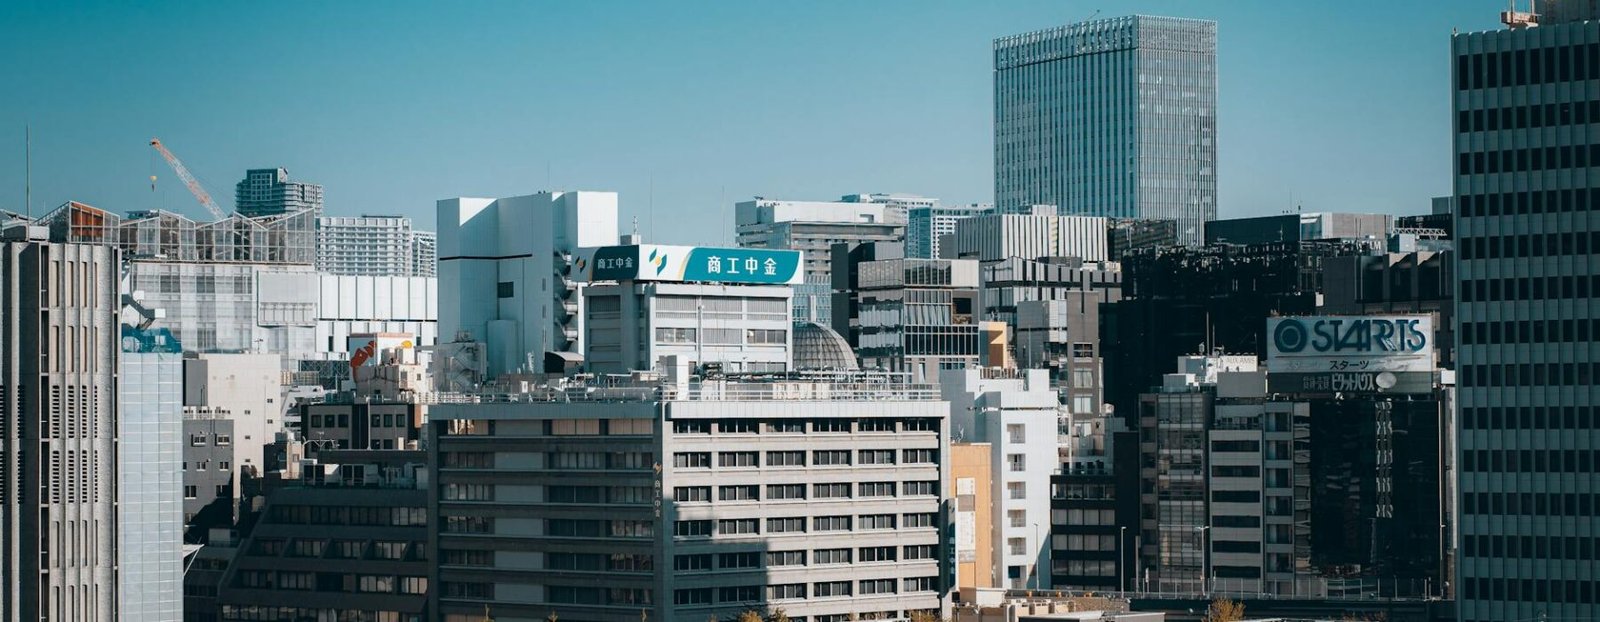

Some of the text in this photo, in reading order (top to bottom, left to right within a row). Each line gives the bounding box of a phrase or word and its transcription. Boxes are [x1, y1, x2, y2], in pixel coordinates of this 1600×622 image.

[598, 257, 633, 269] 商工中金
[707, 256, 777, 275] 商工中金
[1312, 319, 1426, 352] STARTS
[1330, 360, 1369, 370] スターツ
